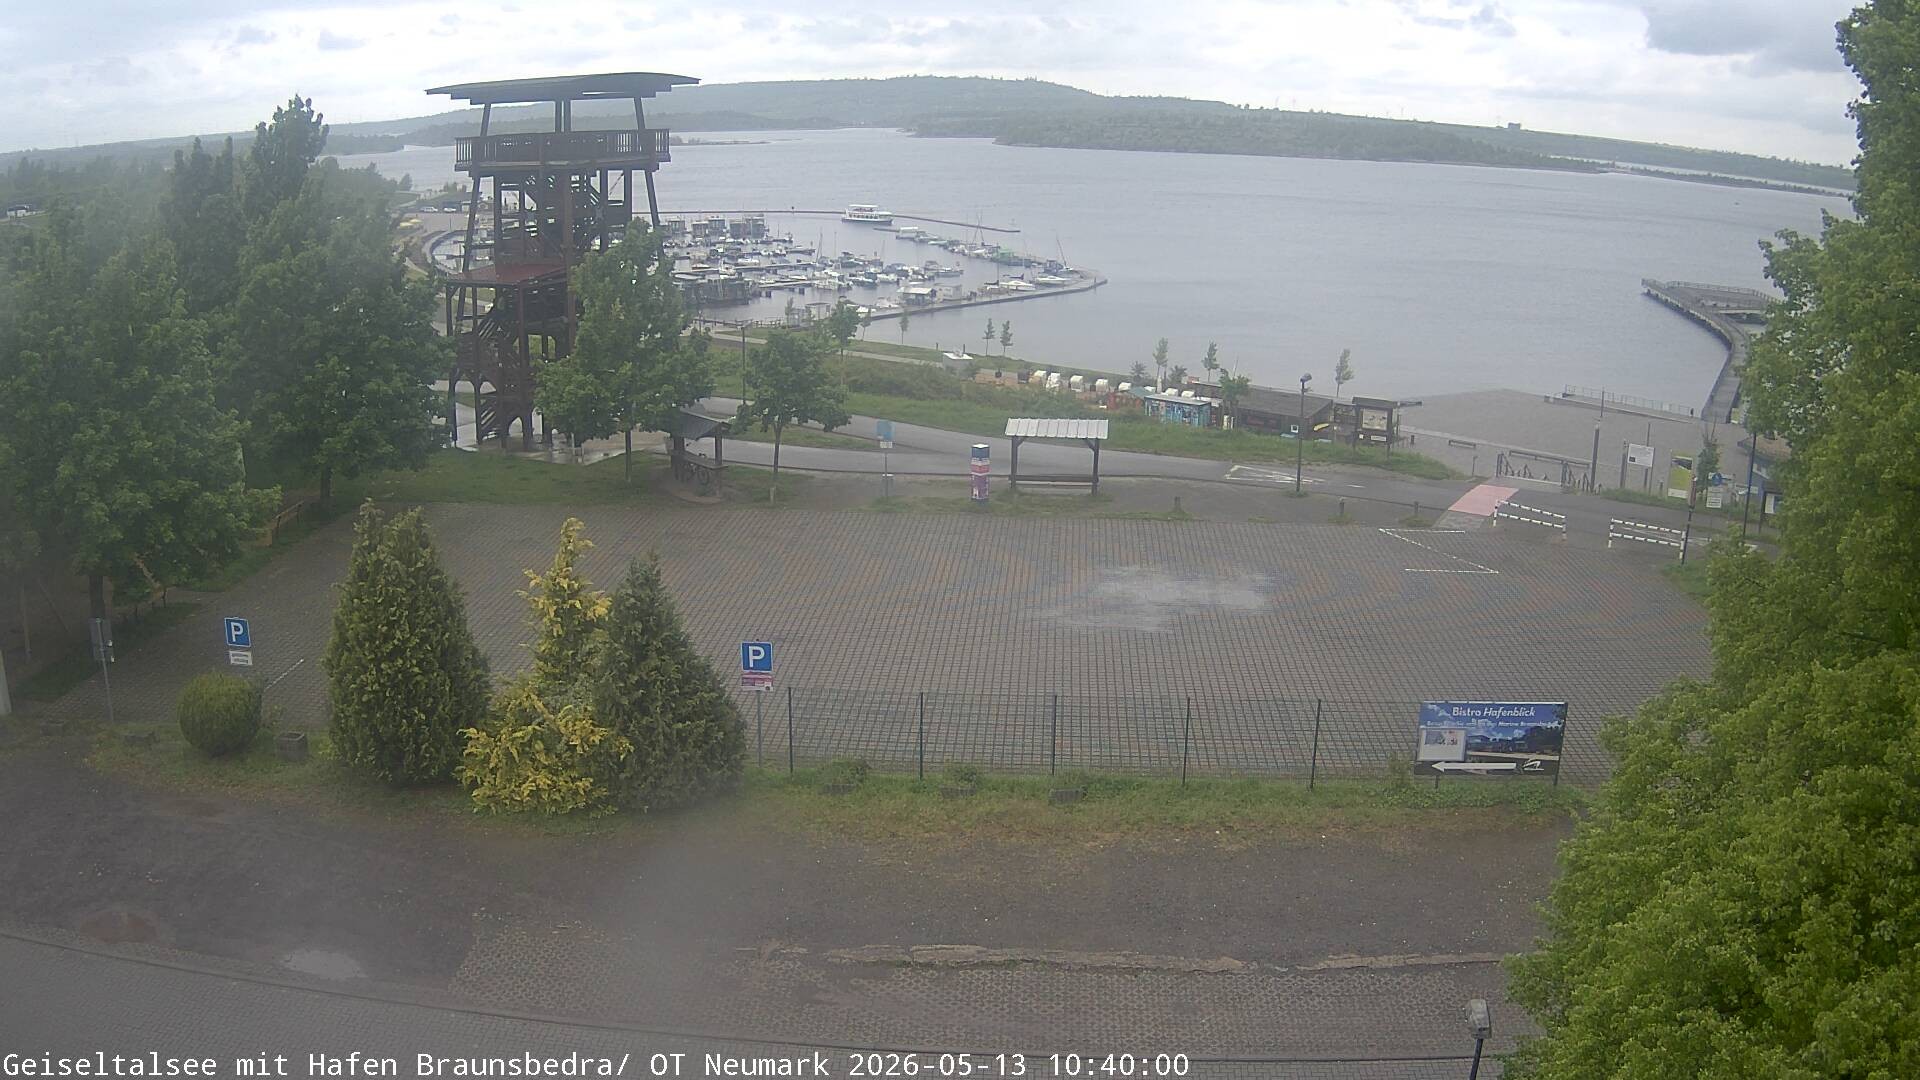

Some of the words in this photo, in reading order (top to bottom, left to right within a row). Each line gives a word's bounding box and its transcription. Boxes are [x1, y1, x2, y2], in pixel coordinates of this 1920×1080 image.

[230, 621, 244, 643] P
[748, 645, 765, 668] P
[1452, 706, 1482, 717] Bistro
[1483, 706, 1536, 718] Hafenblick
